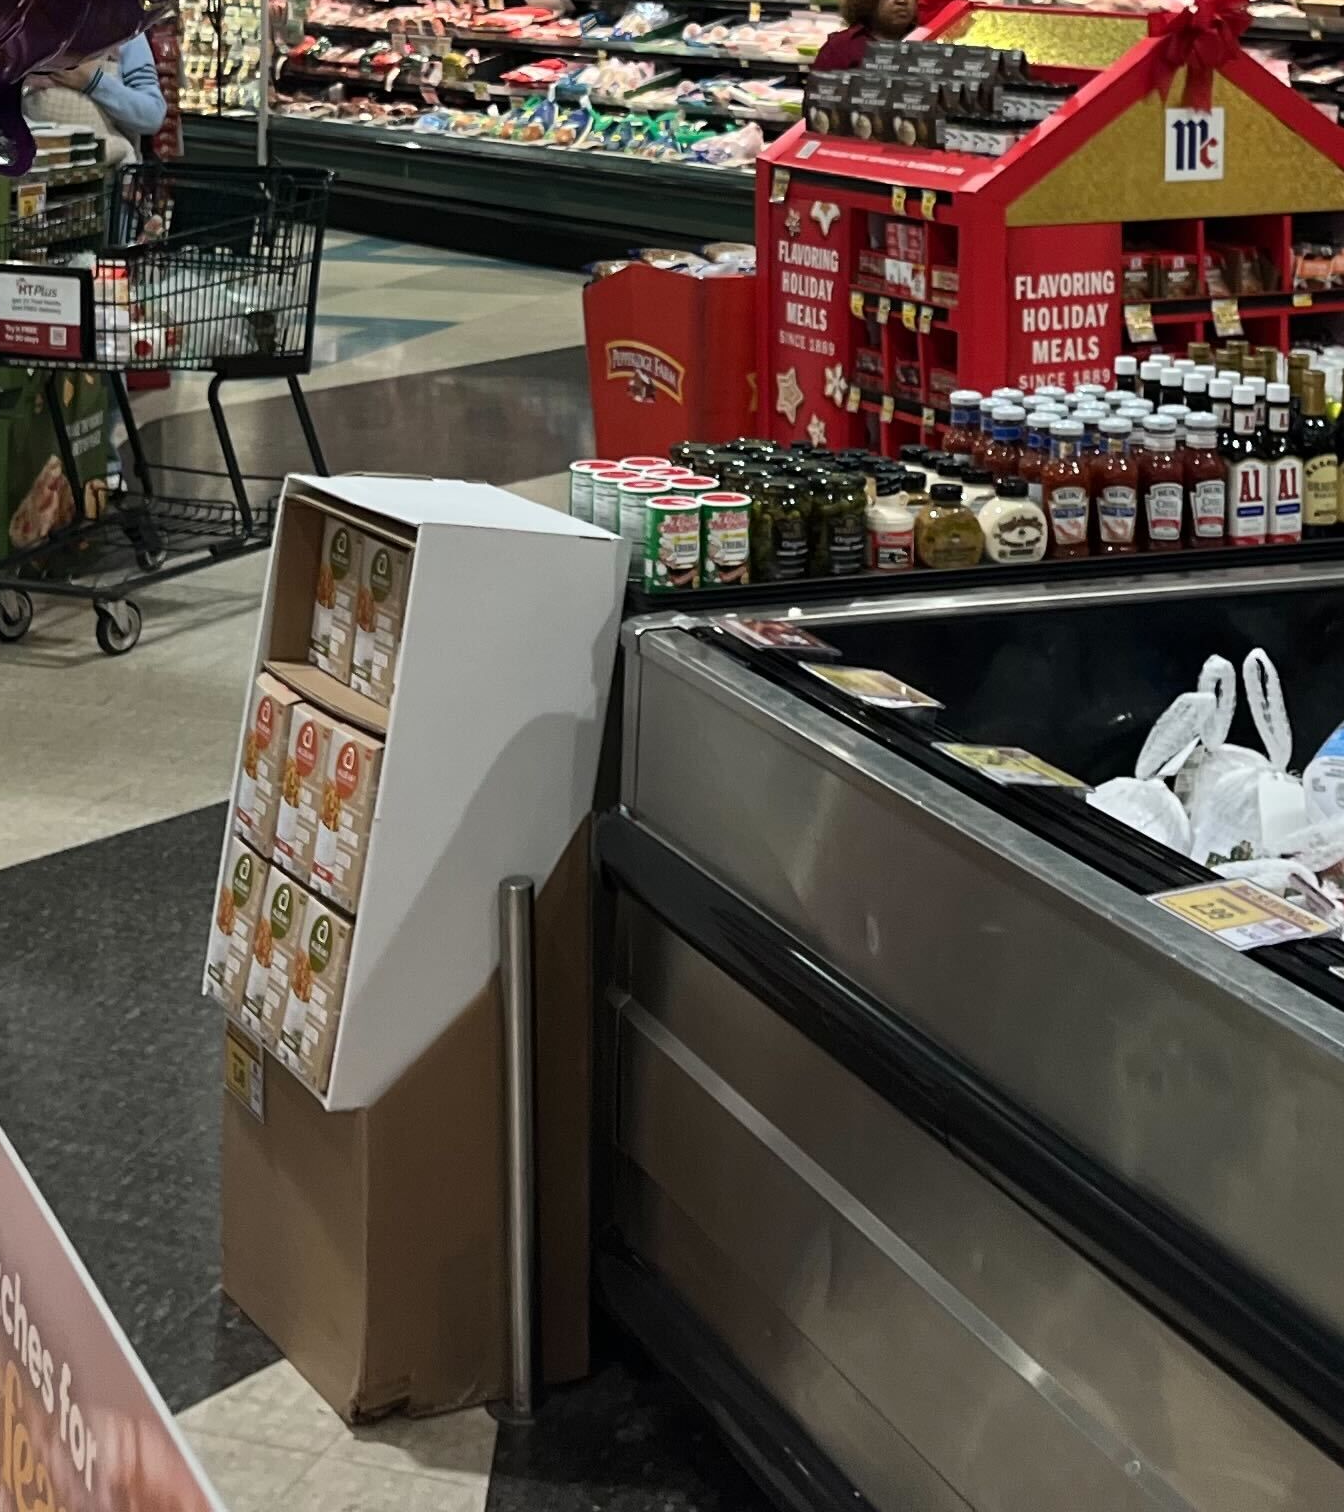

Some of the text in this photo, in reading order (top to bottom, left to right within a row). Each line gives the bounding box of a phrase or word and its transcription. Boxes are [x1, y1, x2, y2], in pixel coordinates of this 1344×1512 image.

[777, 239, 840, 272] FLAVORING
[781, 271, 834, 303] HOLIDAY
[1015, 270, 1115, 301] FLAVORING
[786, 301, 828, 332] MEALS
[1022, 303, 1109, 333] HOLIDAY
[1032, 335, 1100, 365] MEALS
[1018, 371, 1067, 390] SINCE
[57, 1362, 98, 1490] for
